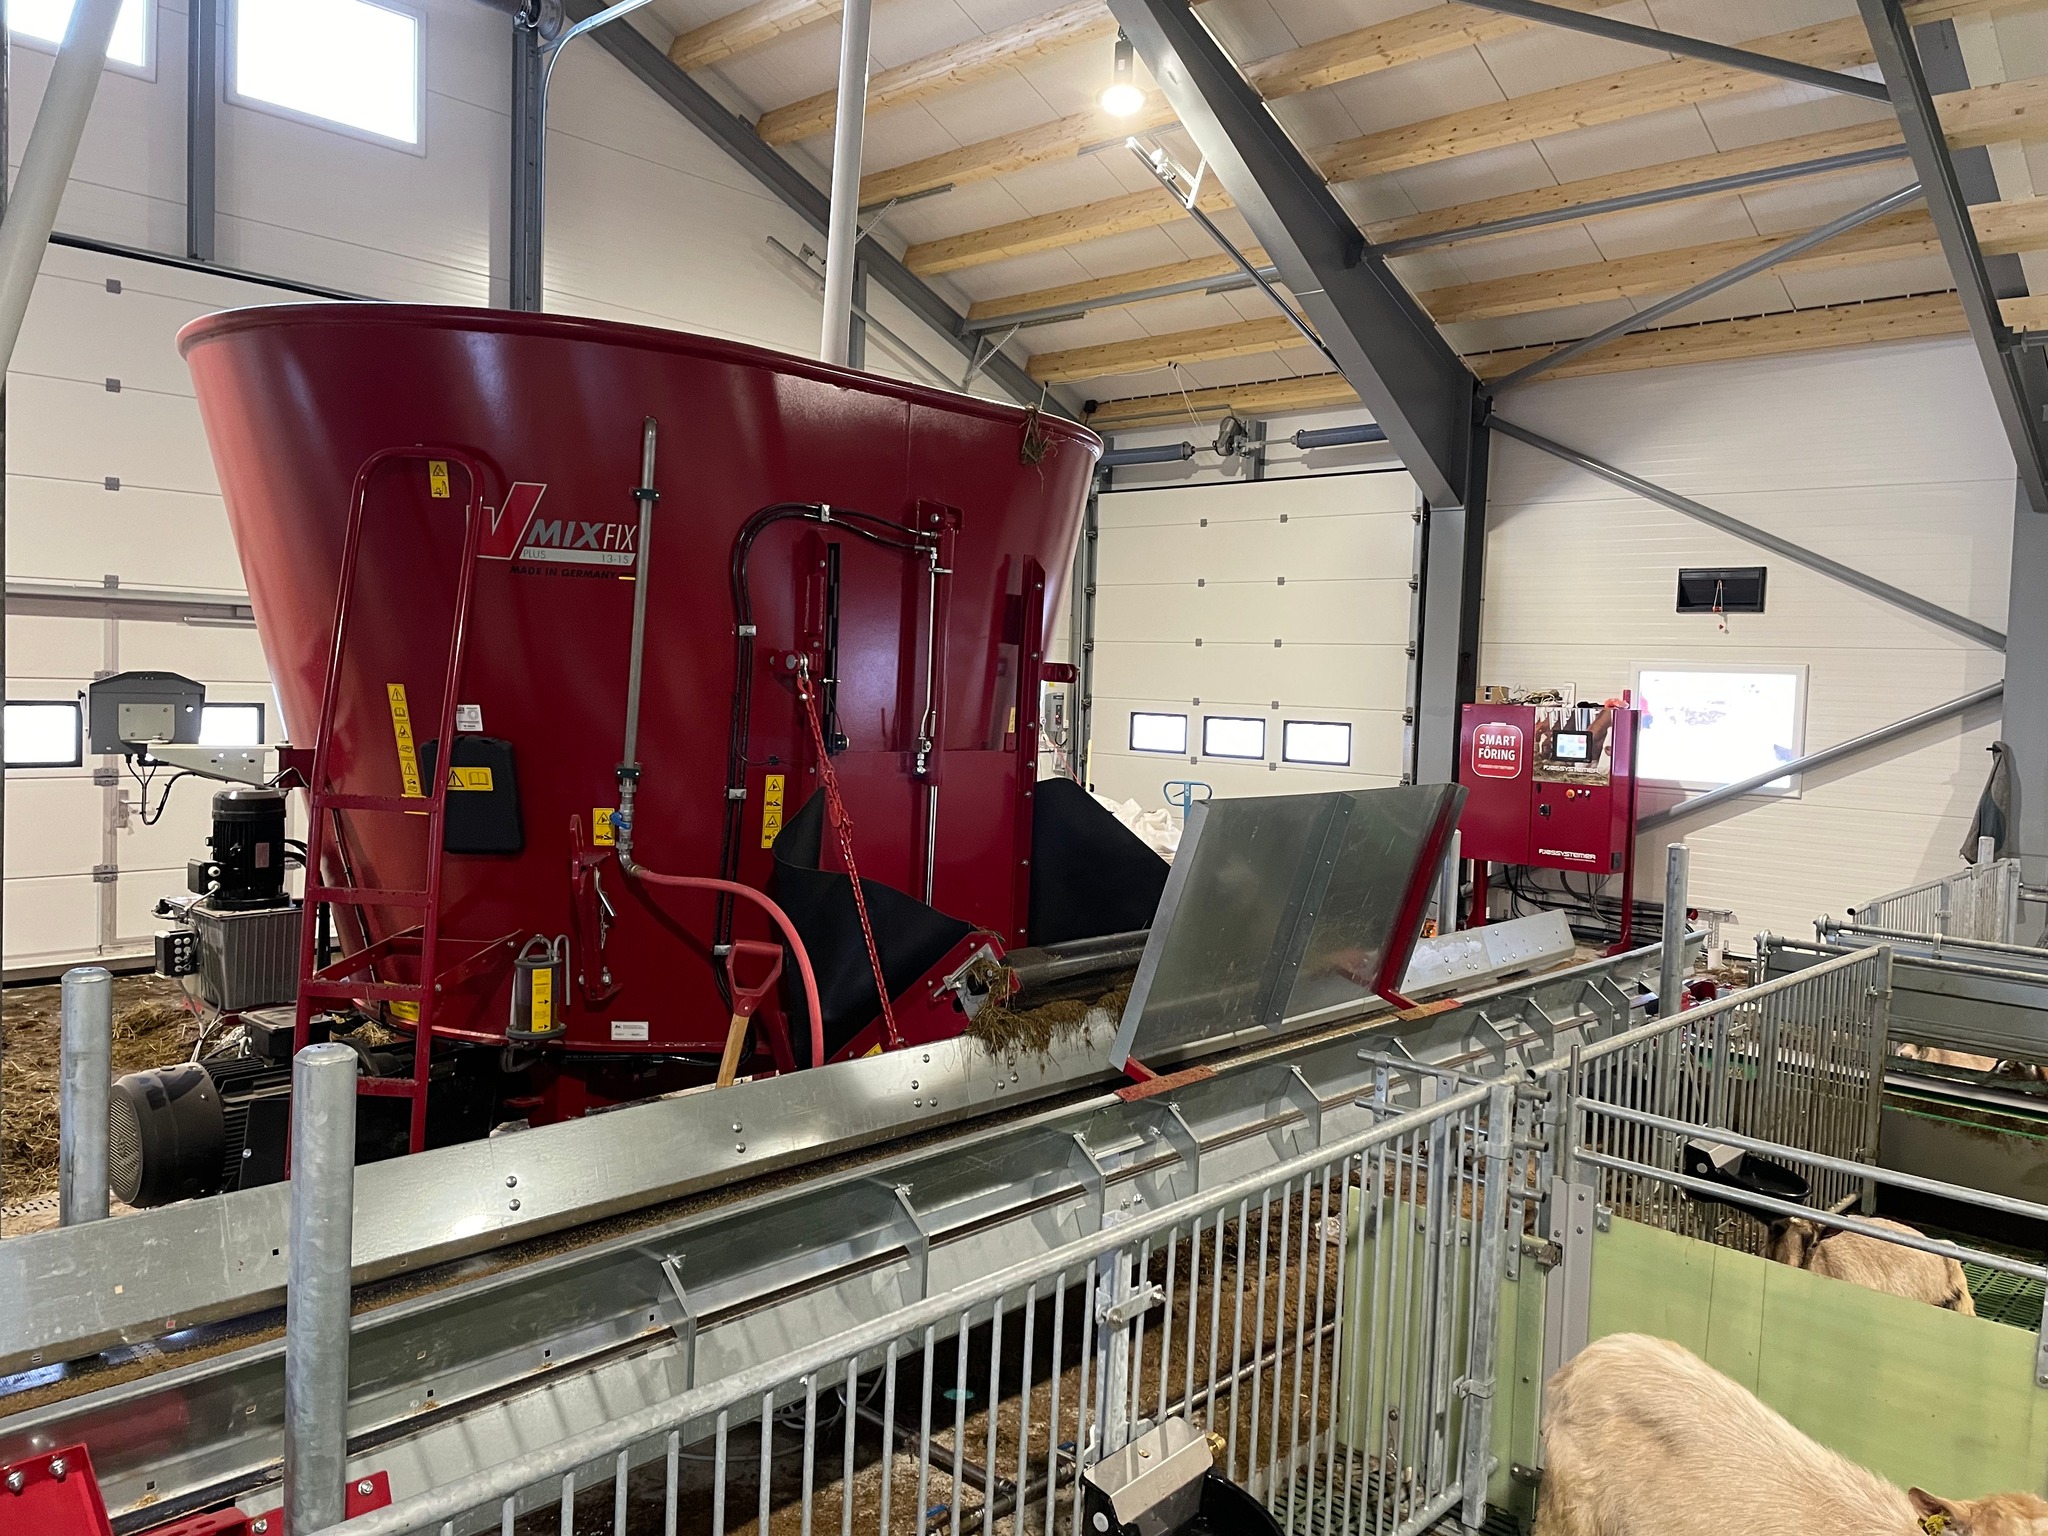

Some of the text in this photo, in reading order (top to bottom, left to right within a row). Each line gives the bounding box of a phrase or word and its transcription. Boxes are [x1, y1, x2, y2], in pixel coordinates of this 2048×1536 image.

[523, 548, 547, 559] PLUS
[511, 566, 616, 579] MADE IN GERMANY
[1479, 733, 1516, 747] SMART
